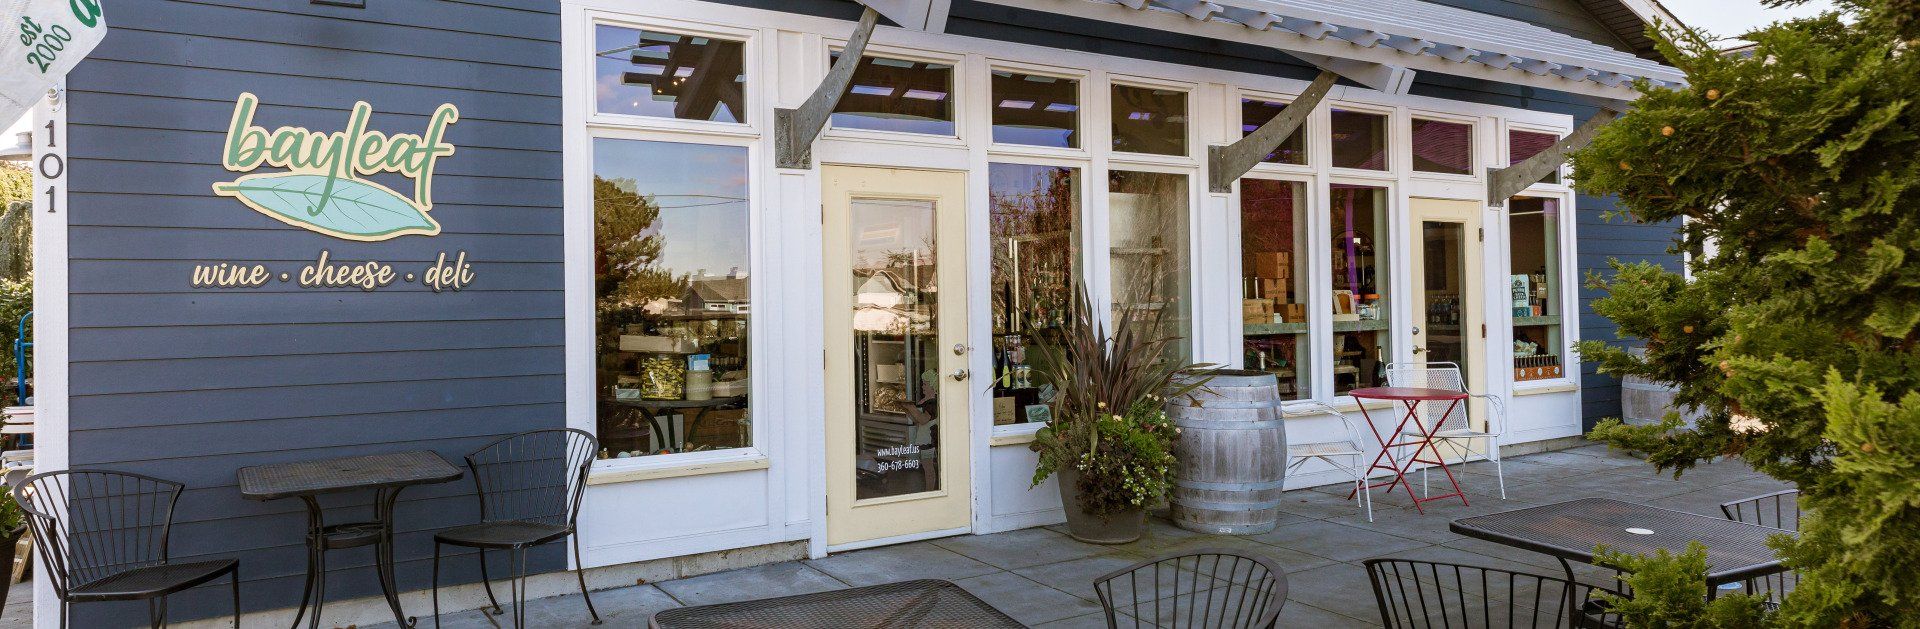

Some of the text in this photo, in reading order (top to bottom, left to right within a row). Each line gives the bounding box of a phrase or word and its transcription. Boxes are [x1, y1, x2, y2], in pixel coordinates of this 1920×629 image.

[20, 16, 43, 47] est
[26, 24, 72, 74] 2000
[39, 120, 64, 213] 101
[226, 96, 457, 217] bayleaf
[193, 250, 475, 291] wine cheese deli
[877, 444, 920, 457] www.bayleaf.us
[877, 459, 920, 473] 360-678-6603
